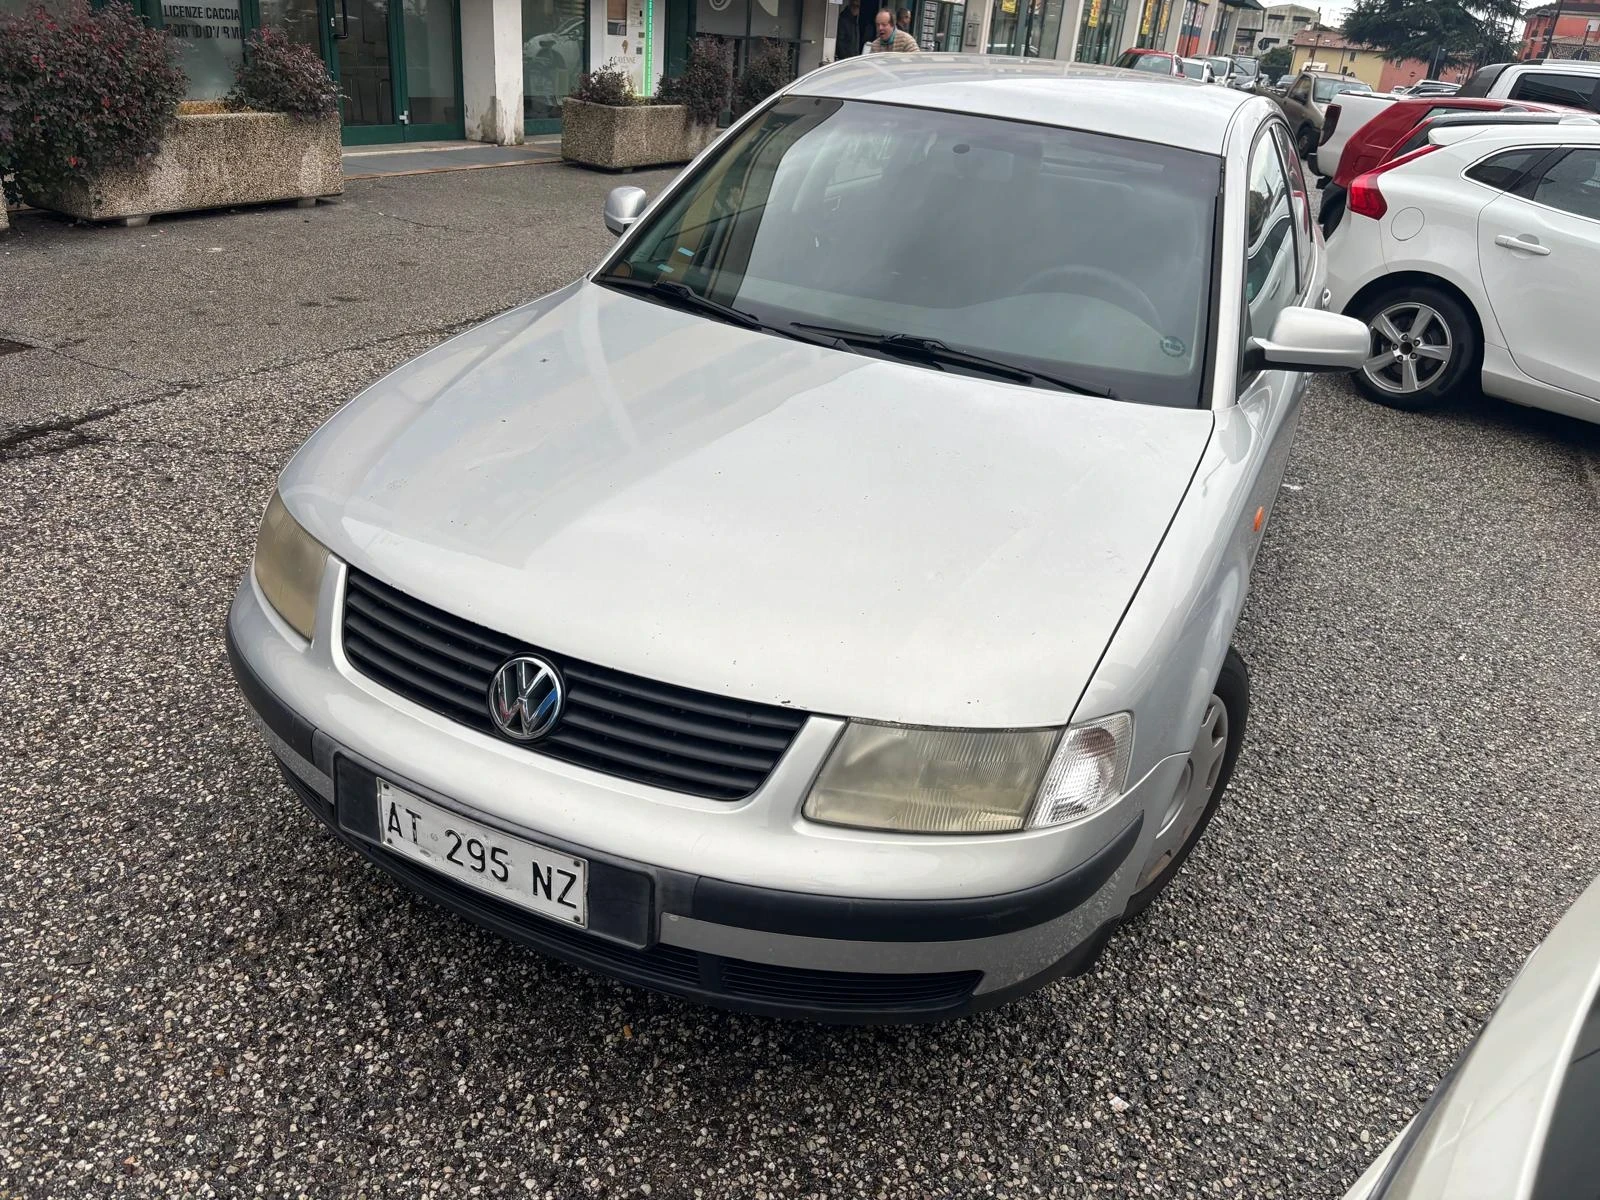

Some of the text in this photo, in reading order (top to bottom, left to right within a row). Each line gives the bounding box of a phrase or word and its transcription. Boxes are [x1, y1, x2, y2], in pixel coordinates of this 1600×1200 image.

[164, 5, 240, 20] LICENZE CACCIA
[387, 802, 577, 909] AT 295 NZ
